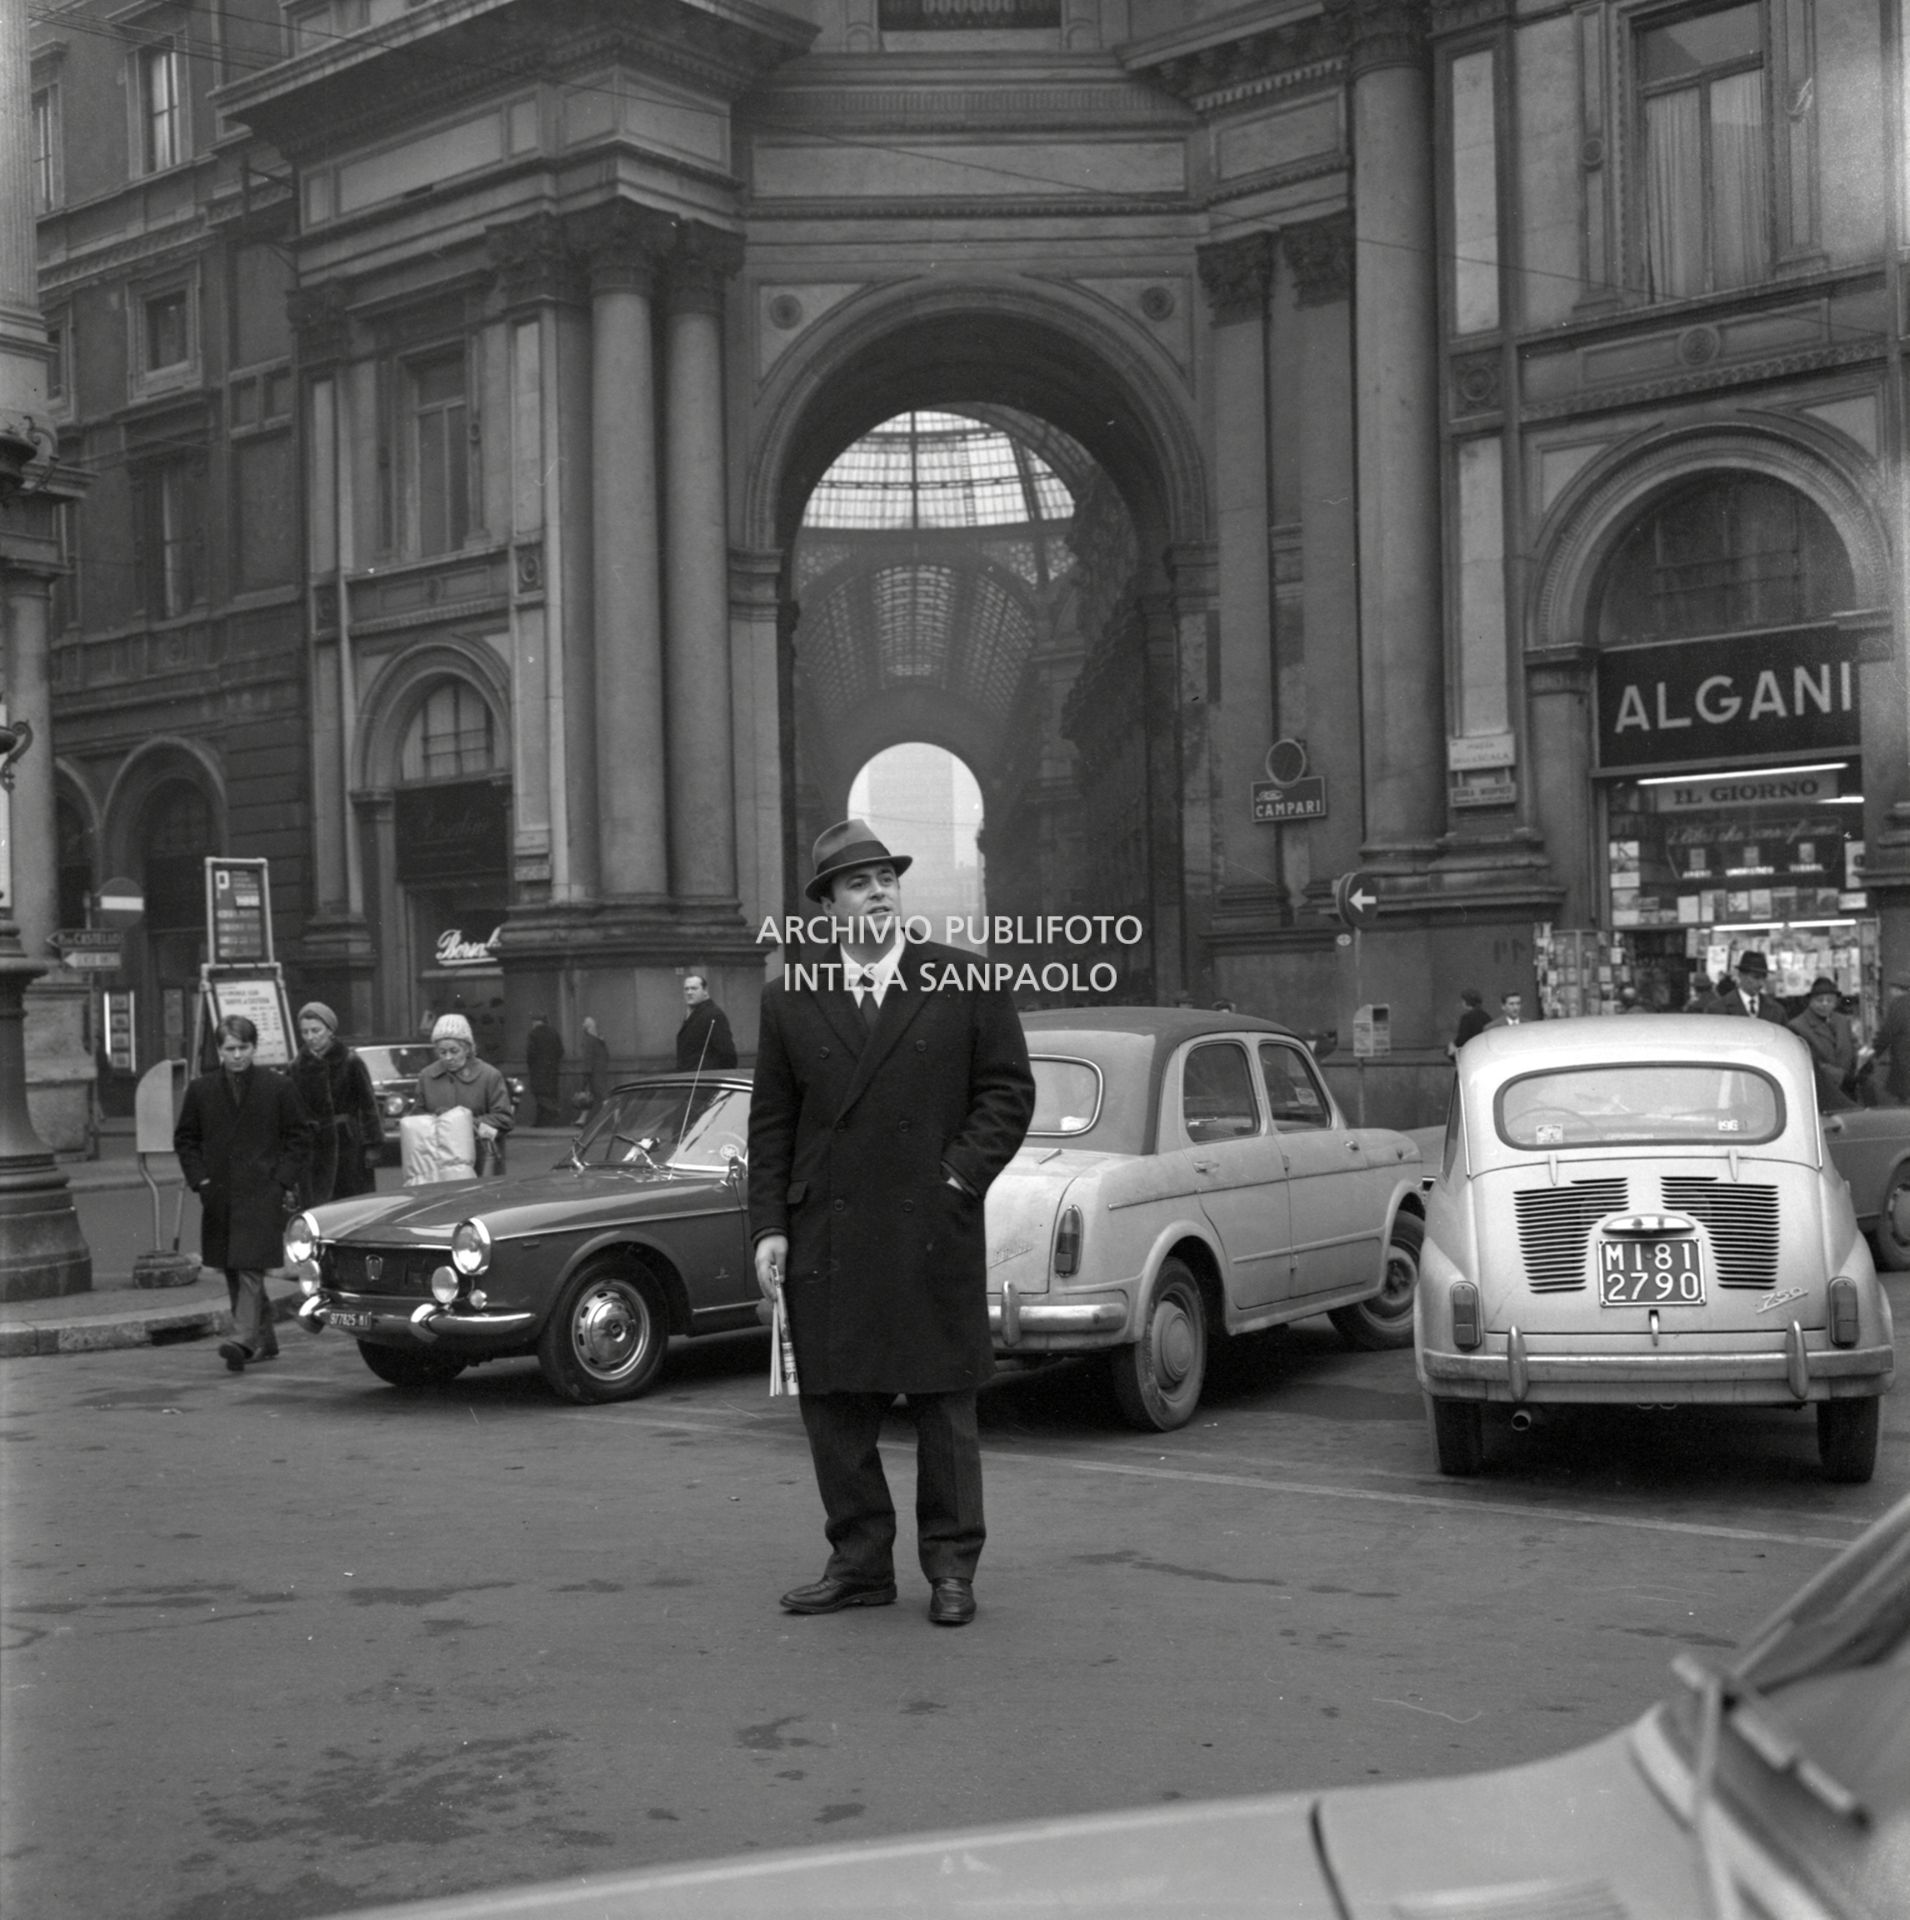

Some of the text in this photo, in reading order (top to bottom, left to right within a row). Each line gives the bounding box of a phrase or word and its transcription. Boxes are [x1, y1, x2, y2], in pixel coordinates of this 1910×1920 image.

[1615, 661, 1853, 734] ALGANI
[1673, 779, 1819, 806] IL GIORNO
[1255, 799, 1321, 818] CAMPARI
[1606, 1271, 1699, 1301] 2790
